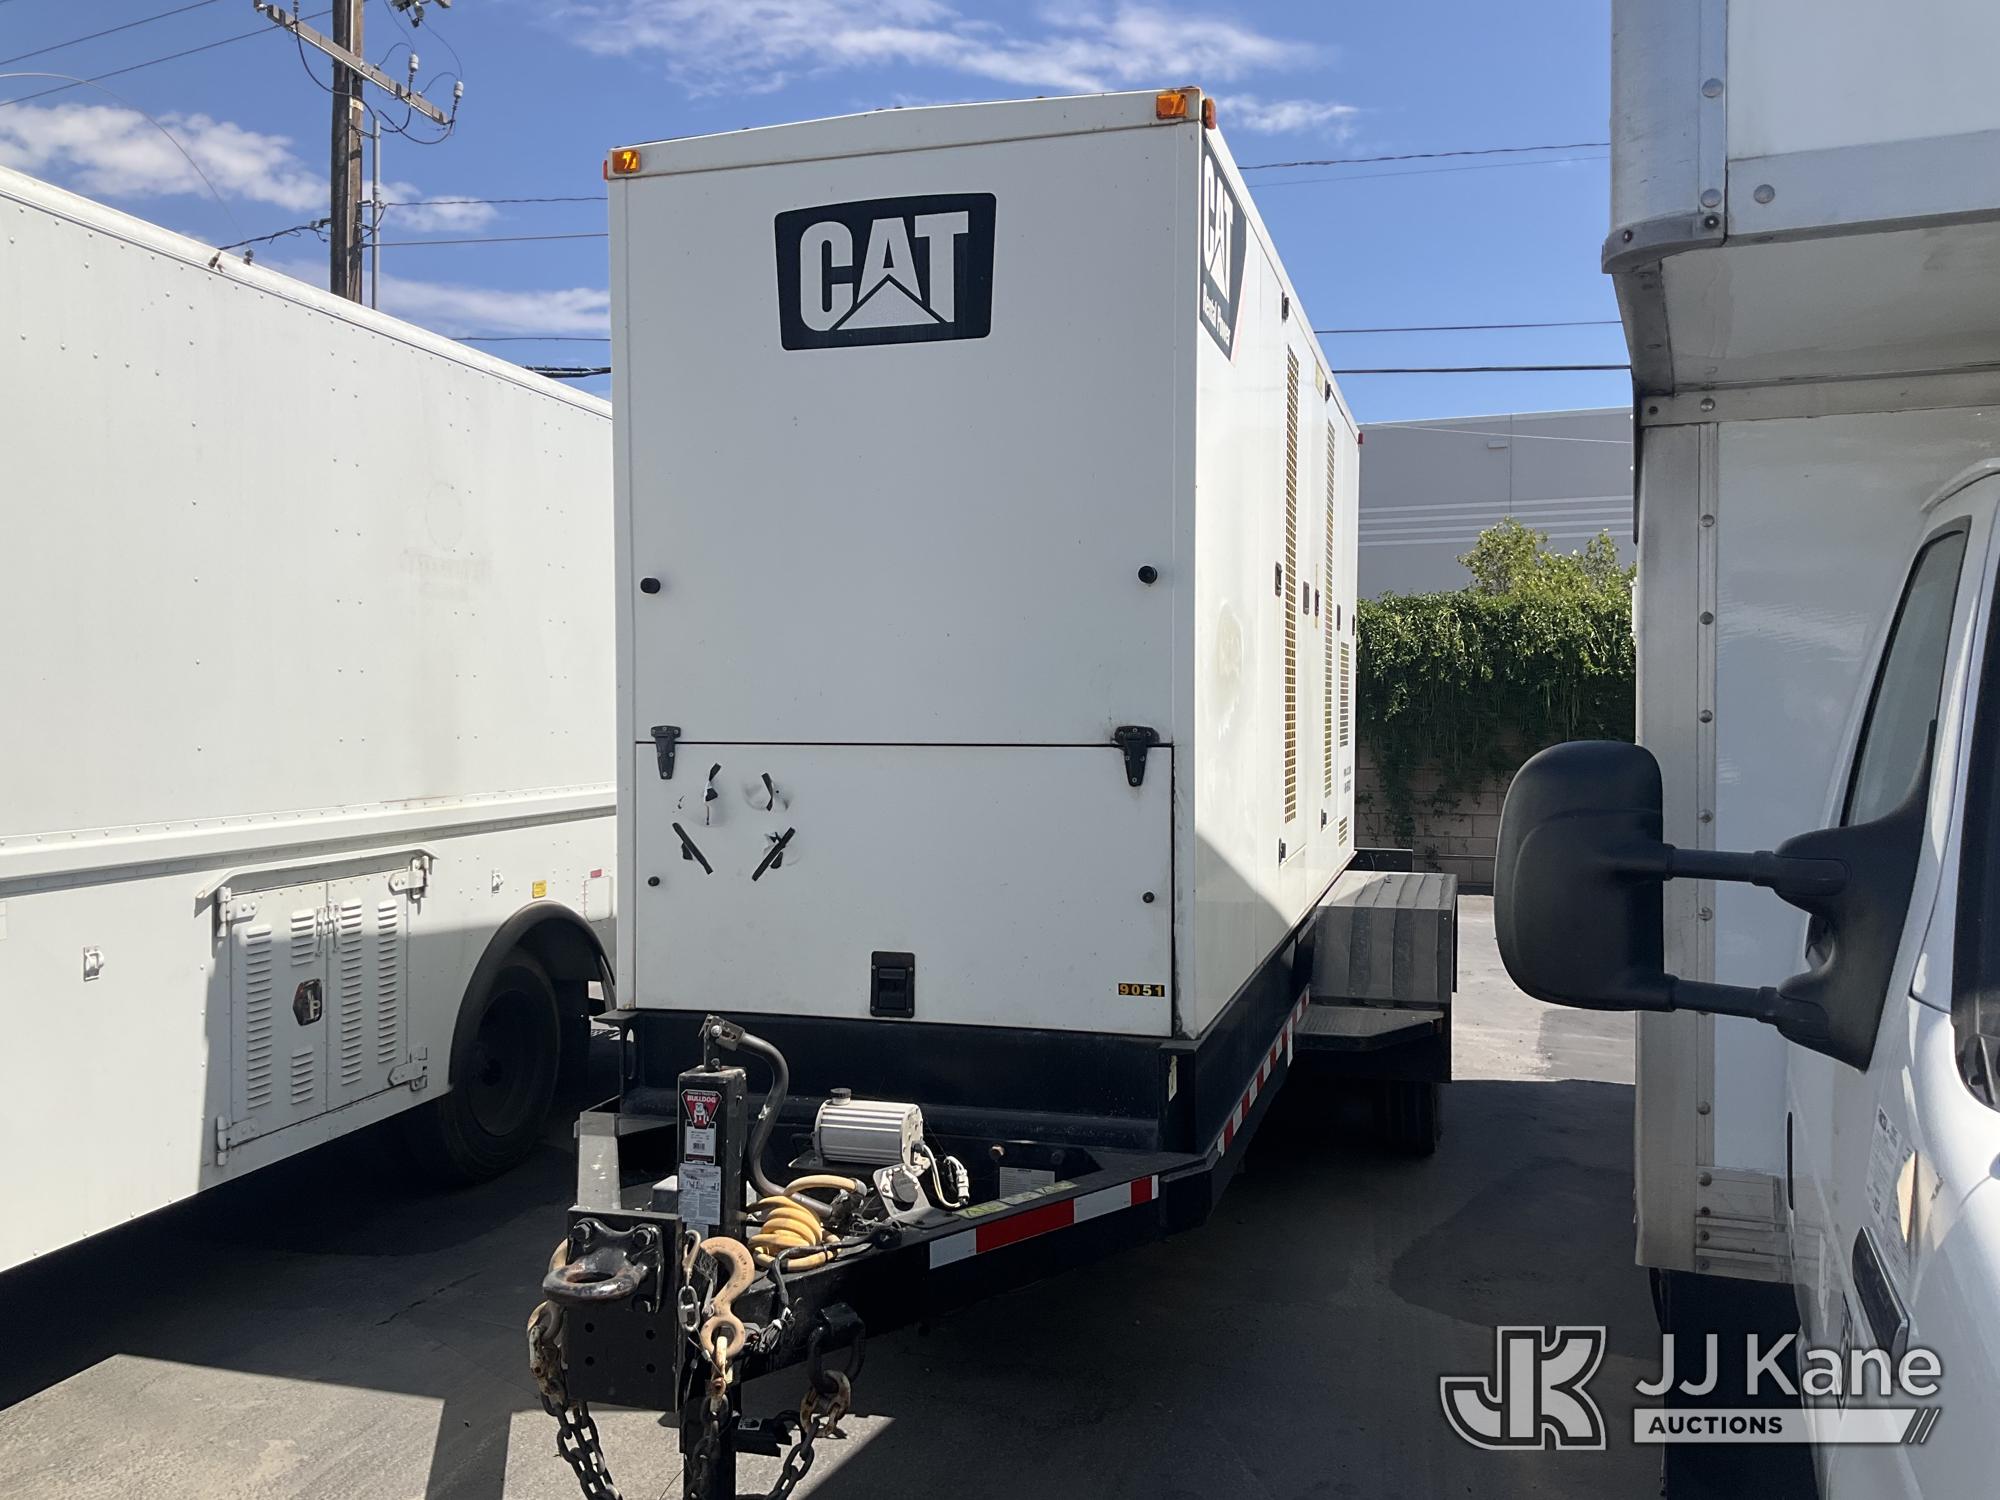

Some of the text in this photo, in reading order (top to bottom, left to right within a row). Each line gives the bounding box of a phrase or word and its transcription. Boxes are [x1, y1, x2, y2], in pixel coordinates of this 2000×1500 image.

[1203, 154, 1233, 304] CAT
[801, 210, 969, 331] CAT
[1119, 984, 1163, 997] 9051
[687, 1095, 716, 1103] BULLDOG
